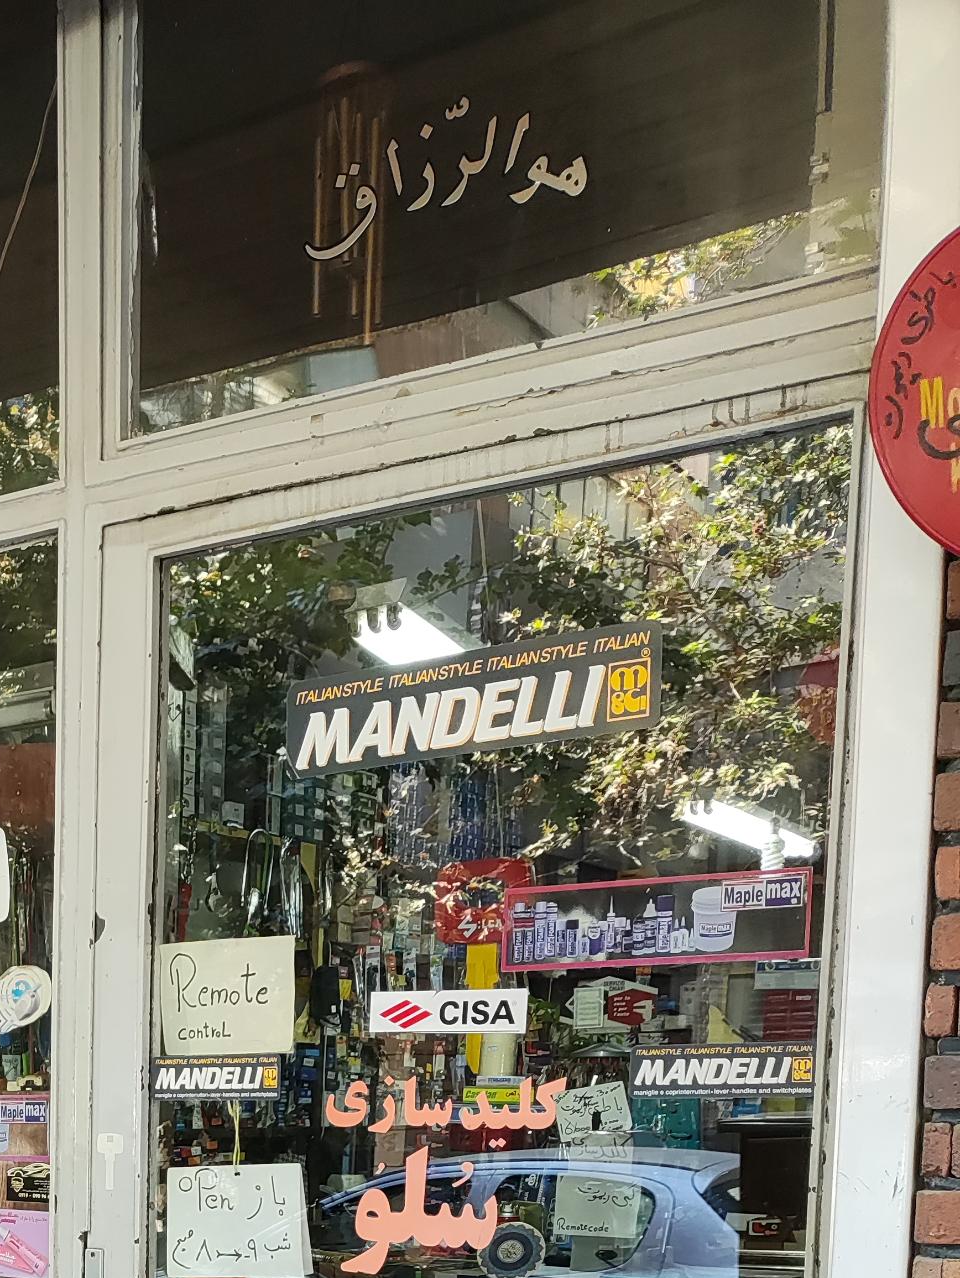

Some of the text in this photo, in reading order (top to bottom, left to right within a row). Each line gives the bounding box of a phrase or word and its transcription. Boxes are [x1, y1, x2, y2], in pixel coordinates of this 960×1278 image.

[593, 630, 651, 654] ITALIAN
[295, 664, 607, 771] MANDELLI
[723, 878, 801, 906] Maple max
[170, 953, 268, 1012] Remote
[440, 1000, 515, 1025] CISA
[155, 1066, 263, 1090] MANDELLI
[634, 1057, 792, 1085] MANDELLI
[0, 1104, 46, 1119] Maple max
